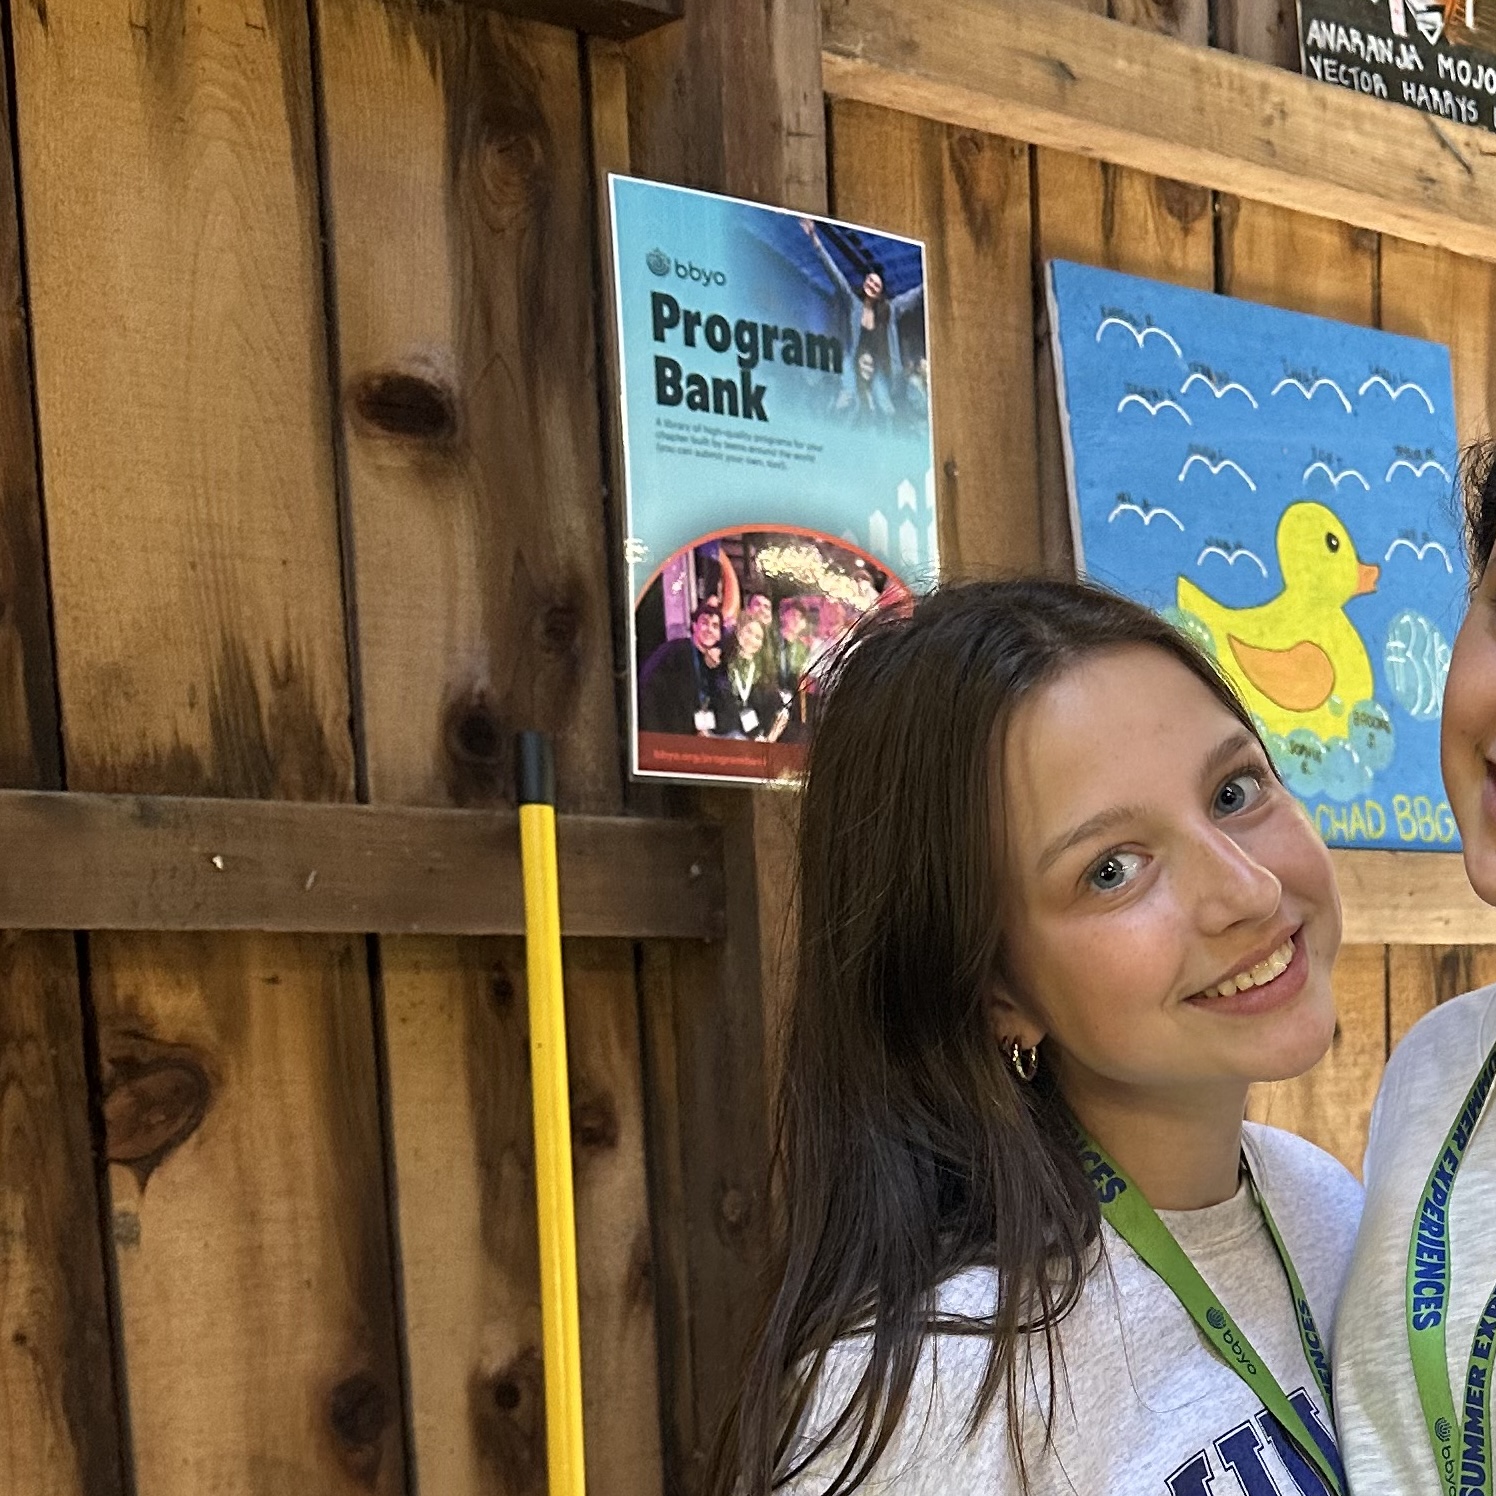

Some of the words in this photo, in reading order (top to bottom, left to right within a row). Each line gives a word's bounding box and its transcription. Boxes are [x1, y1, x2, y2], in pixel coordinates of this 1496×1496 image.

[674, 260, 726, 287] bbyo
[650, 291, 844, 375] Program
[654, 355, 769, 422] Bank
[1391, 794, 1456, 843] BBG
[1412, 1145, 1459, 1331] EXPERIENCES
[1223, 1327, 1257, 1375] bbyo
